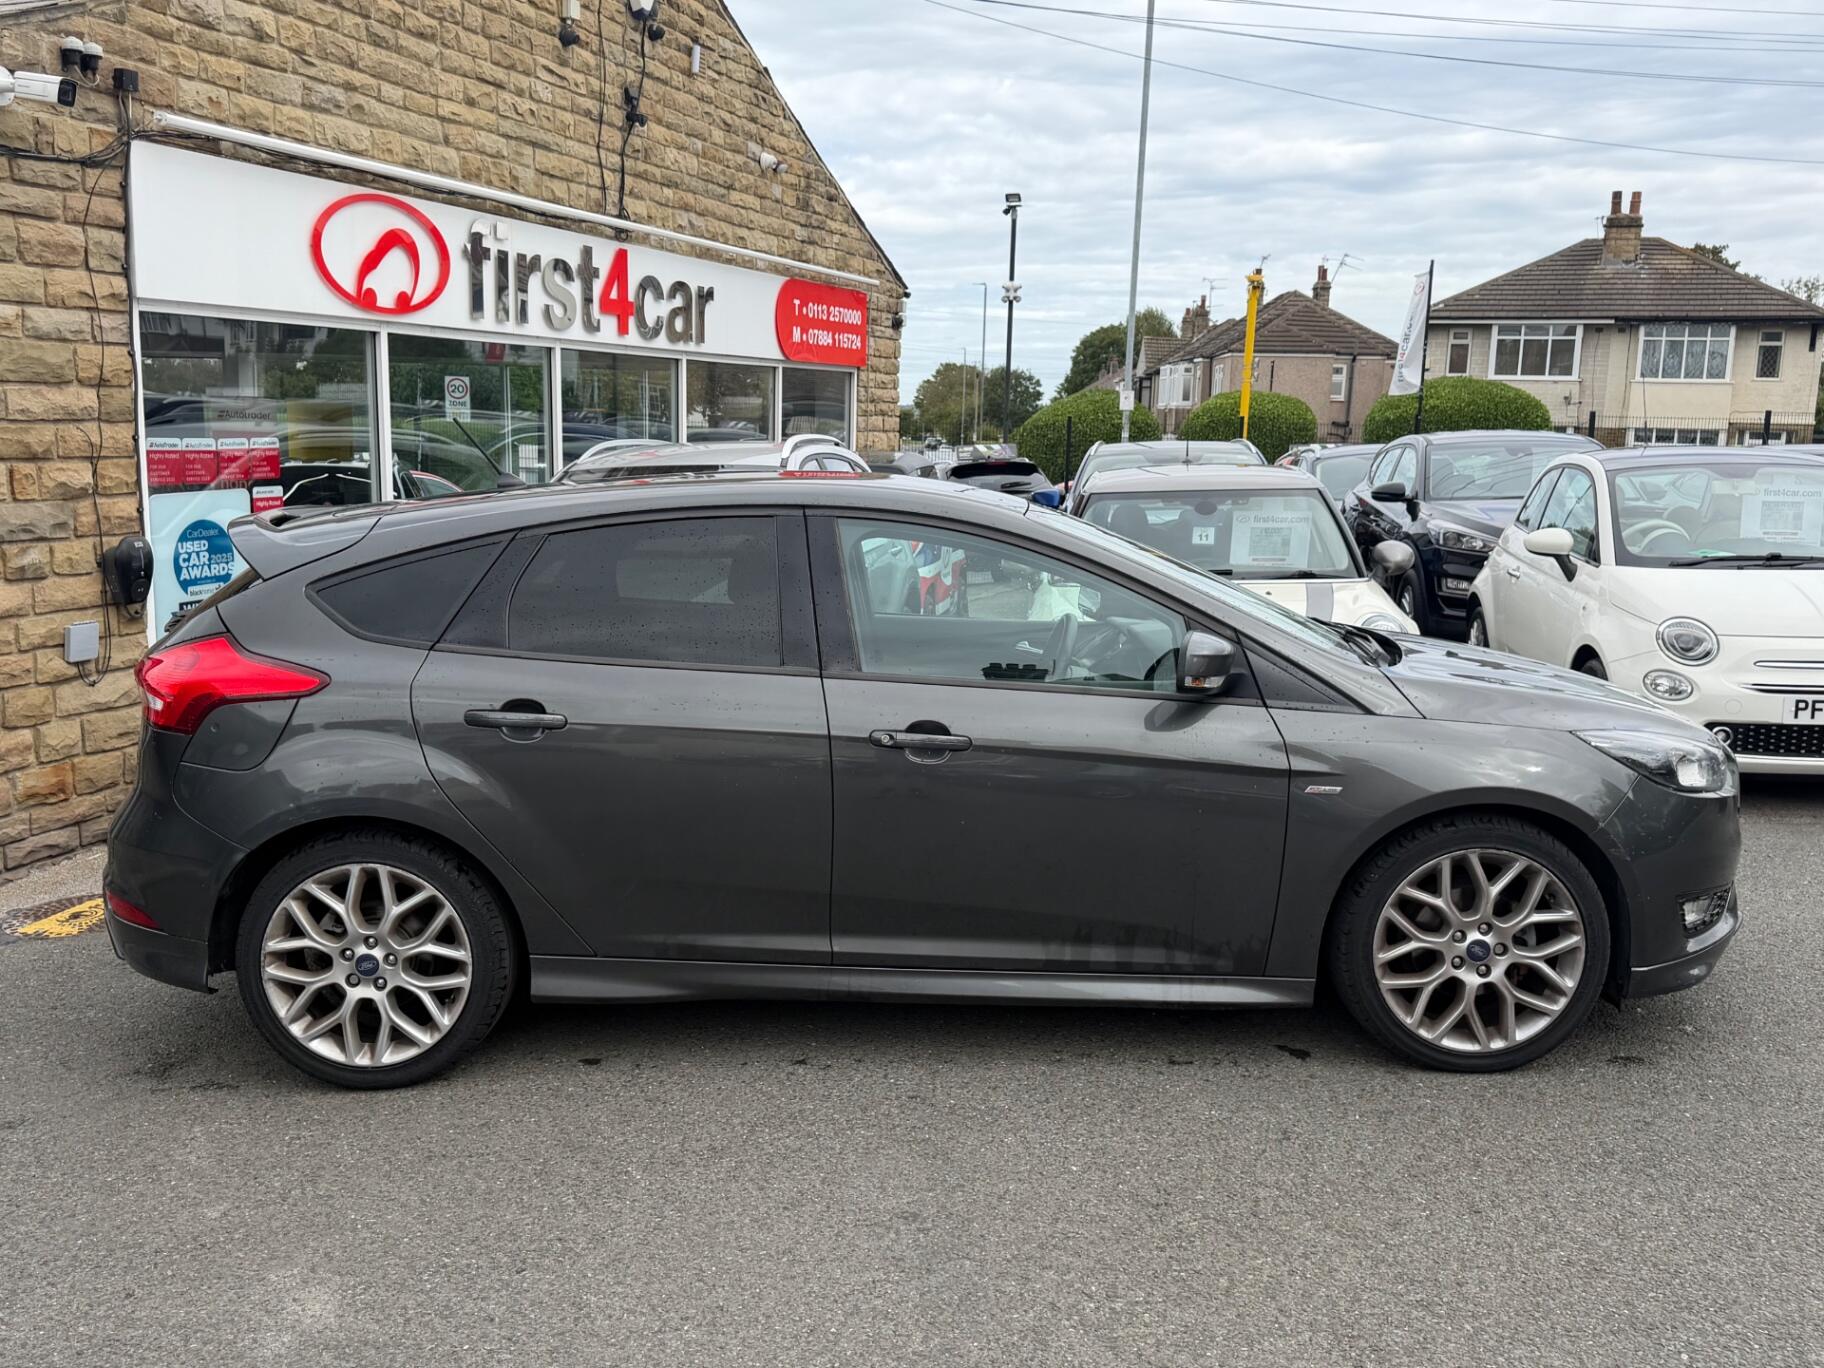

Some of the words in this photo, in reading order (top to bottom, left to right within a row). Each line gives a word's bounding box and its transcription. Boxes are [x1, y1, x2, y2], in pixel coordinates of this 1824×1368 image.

[464, 218, 714, 346] first4car
[793, 298, 801, 316] T
[807, 302, 827, 320] 0113
[829, 305, 862, 325] 2570000
[792, 325, 801, 343] M
[807, 328, 833, 347] 07884
[834, 331, 862, 350] 115724
[450, 383, 465, 394] 20
[1763, 487, 1822, 497] first4car.com
[1253, 513, 1310, 524] first4car.com
[1198, 533, 1209, 542] 11
[178, 540, 209, 553] USED
[179, 551, 209, 568] CAR
[210, 552, 233, 563] 2025
[180, 561, 235, 581] AWARDS
[1794, 699, 1824, 720] PF
